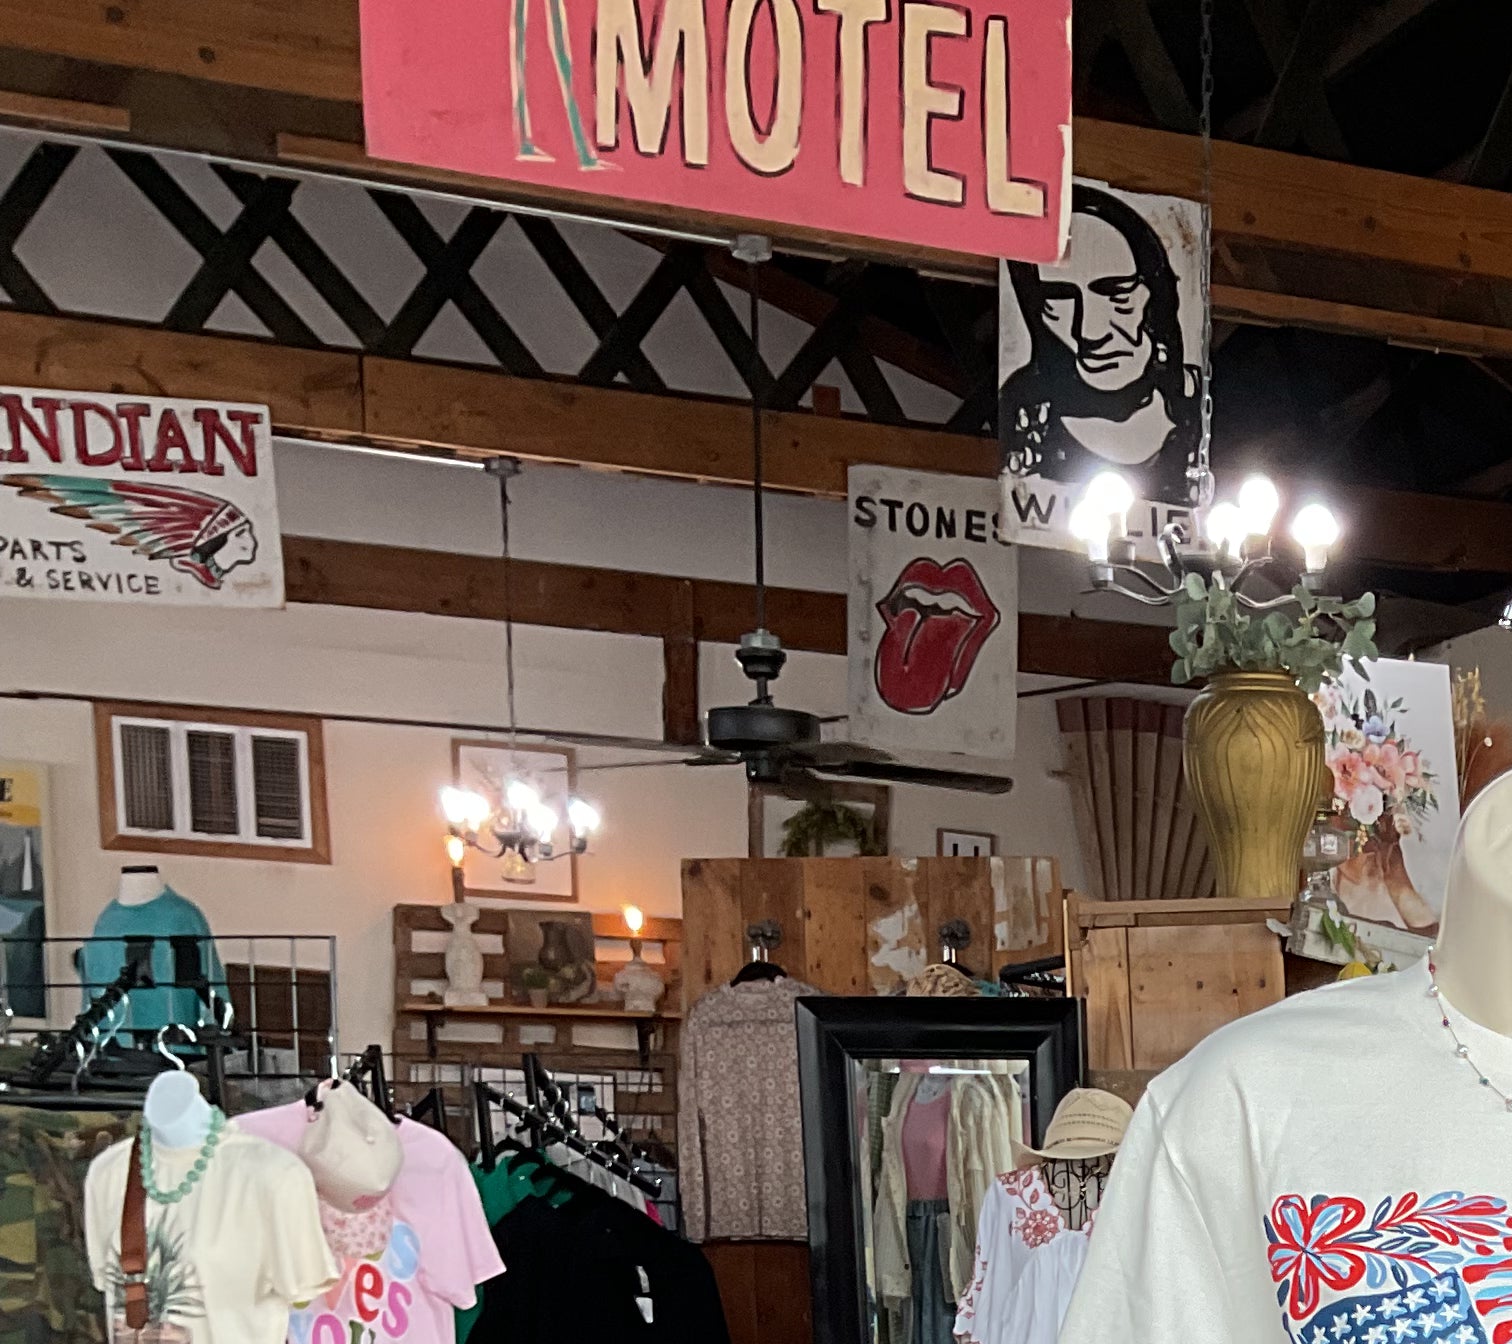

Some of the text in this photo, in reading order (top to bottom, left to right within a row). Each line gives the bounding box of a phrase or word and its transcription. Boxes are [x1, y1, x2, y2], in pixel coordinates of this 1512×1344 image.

[593, 0, 1048, 218] MOTEL
[16, 566, 161, 595] & SERVICE
